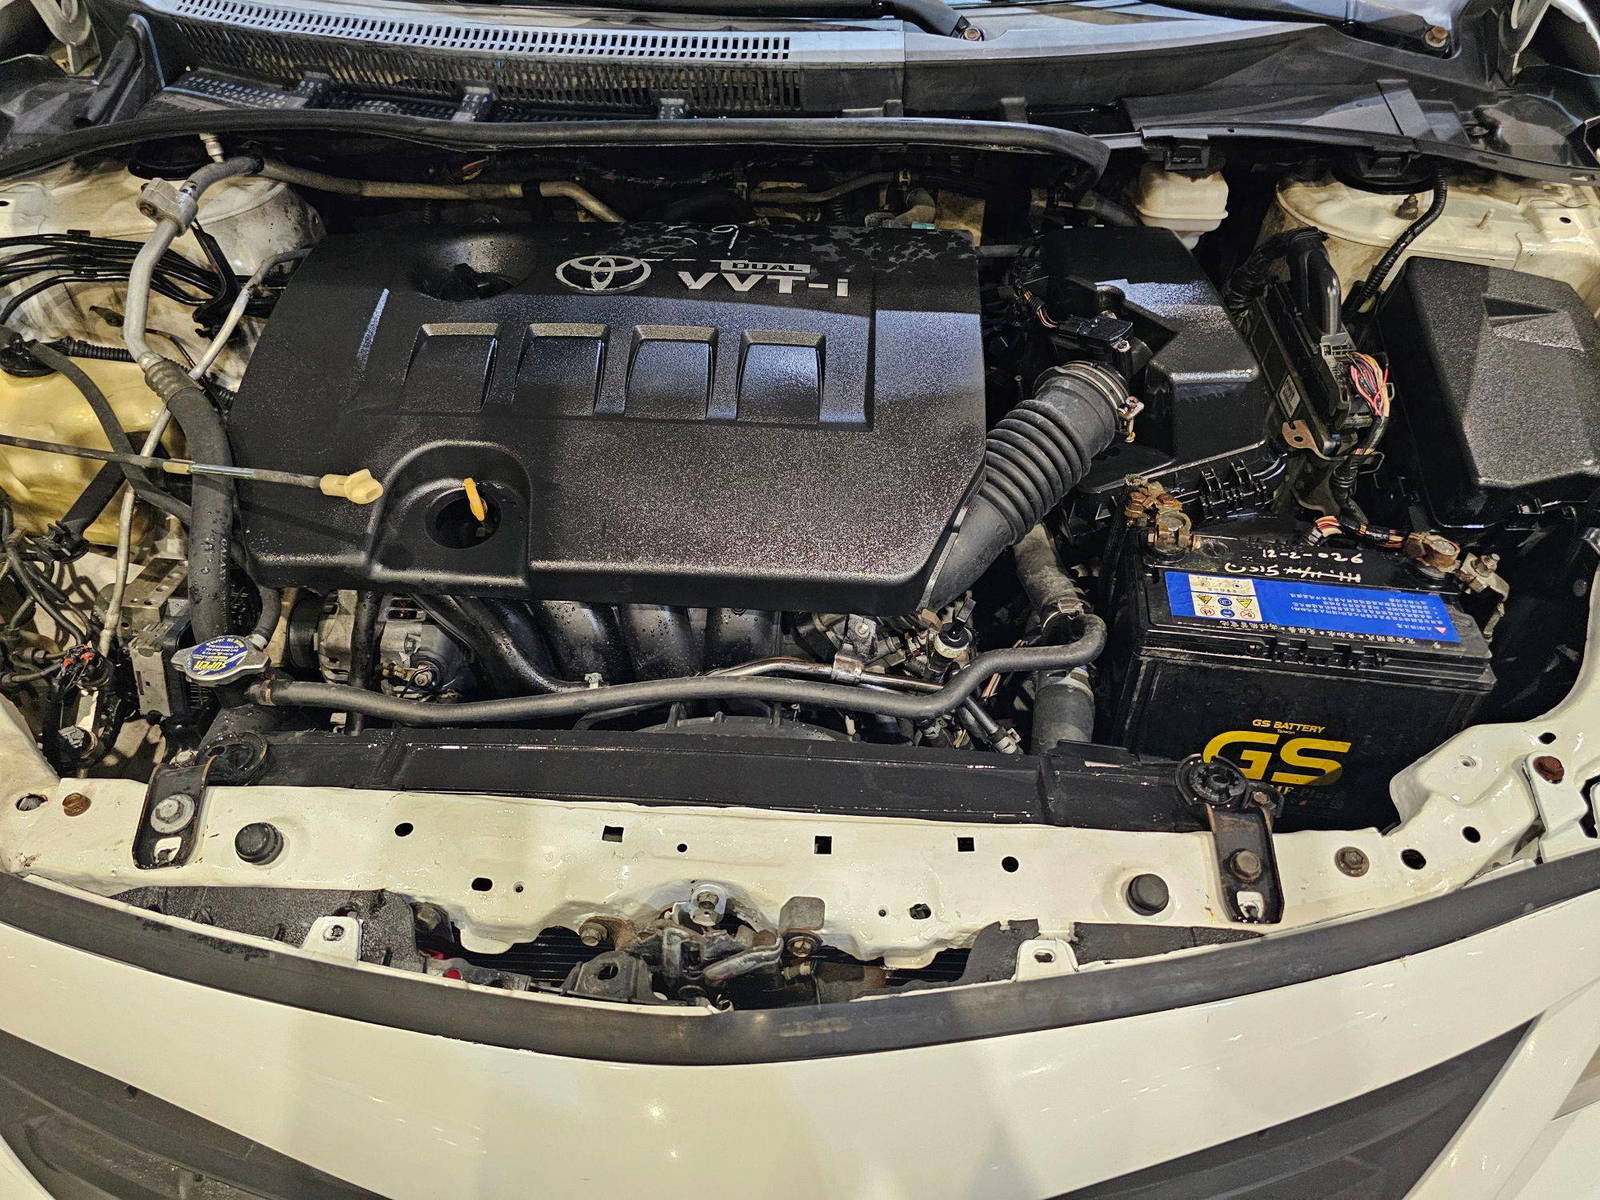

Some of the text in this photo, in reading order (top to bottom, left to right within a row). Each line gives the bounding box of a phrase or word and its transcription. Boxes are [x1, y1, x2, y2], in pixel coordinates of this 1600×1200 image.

[732, 261, 803, 273] DUAL
[677, 271, 849, 298] VVT-i
[194, 660, 226, 672] SUPER
[1252, 719, 1326, 734] GS BATTERY
[1203, 731, 1351, 786] GS
